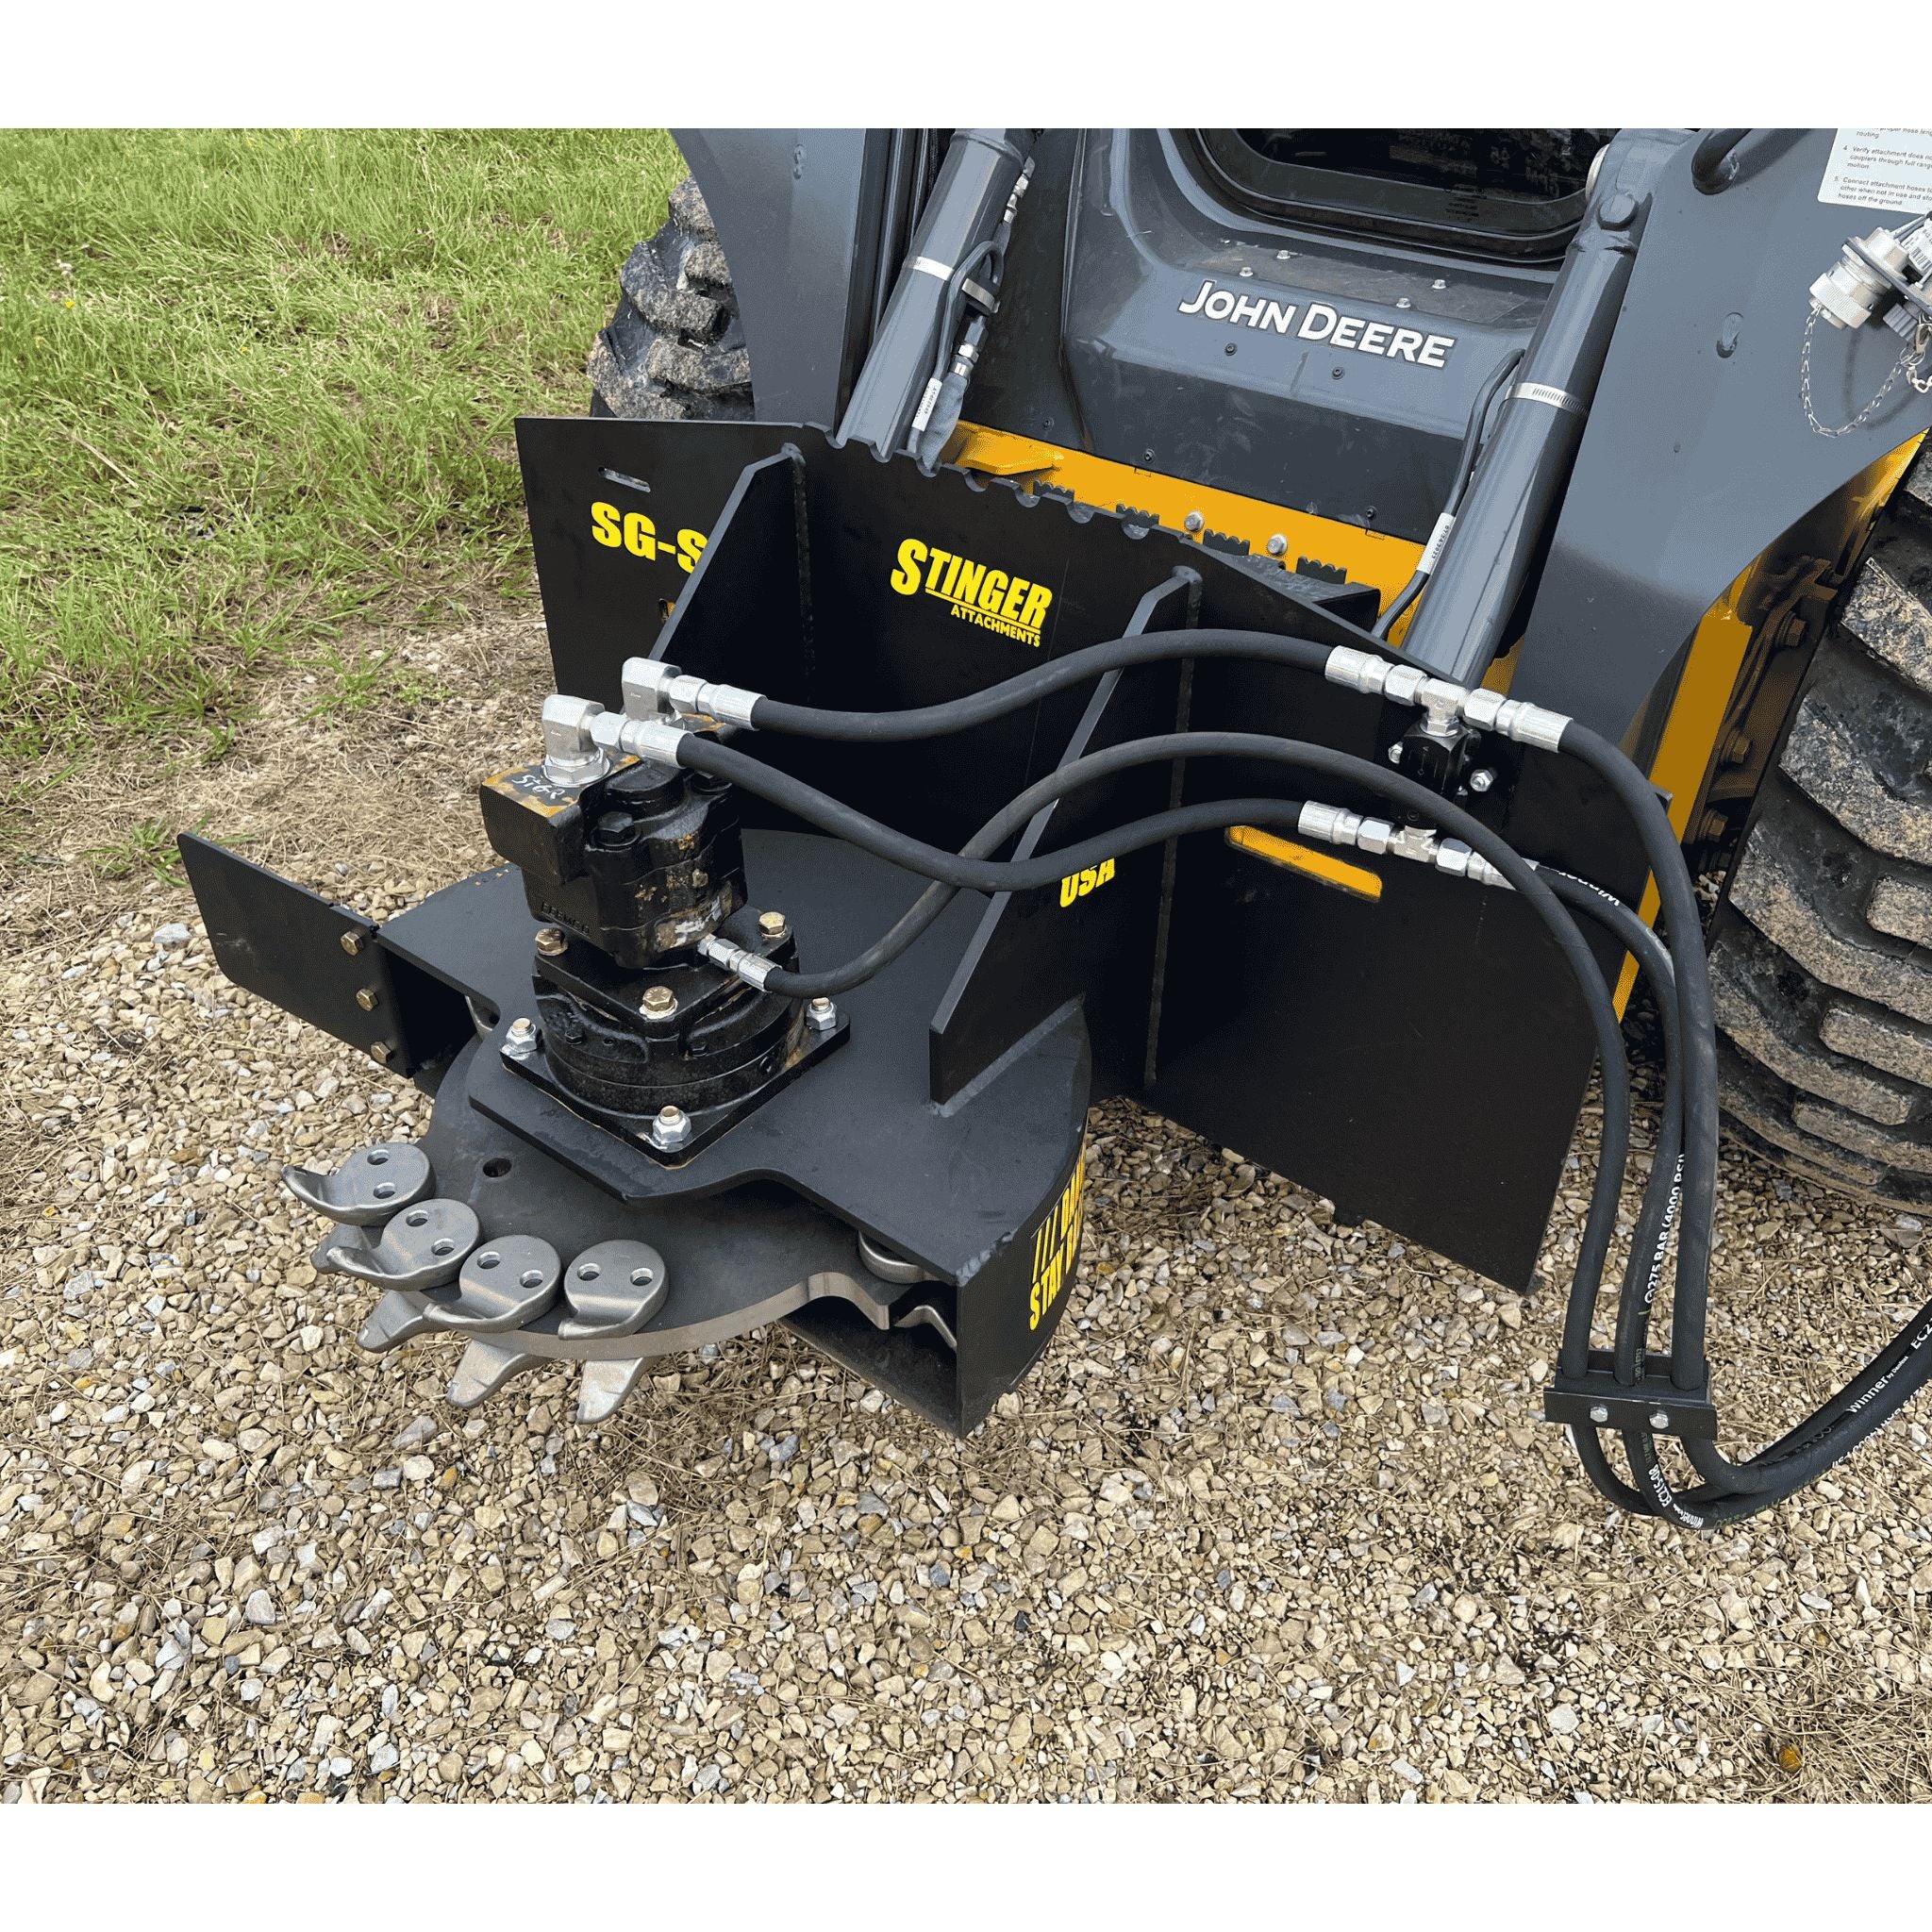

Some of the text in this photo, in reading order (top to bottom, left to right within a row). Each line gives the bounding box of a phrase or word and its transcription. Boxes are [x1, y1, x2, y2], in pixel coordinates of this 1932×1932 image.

[1853, 145, 1870, 154] Verify
[1878, 158, 1903, 166] through
[1842, 176, 1869, 186] Connect
[1178, 279, 1456, 368] JOHN DEERE
[591, 501, 708, 574] SG-S
[950, 604, 1041, 647] ATTACHMENTS
[1661, 1186, 1681, 1229] (4000
[1654, 1231, 1670, 1262] BAR
[1846, 1374, 1890, 1413] Winner
[1648, 1463, 1673, 1507] EC215-08
